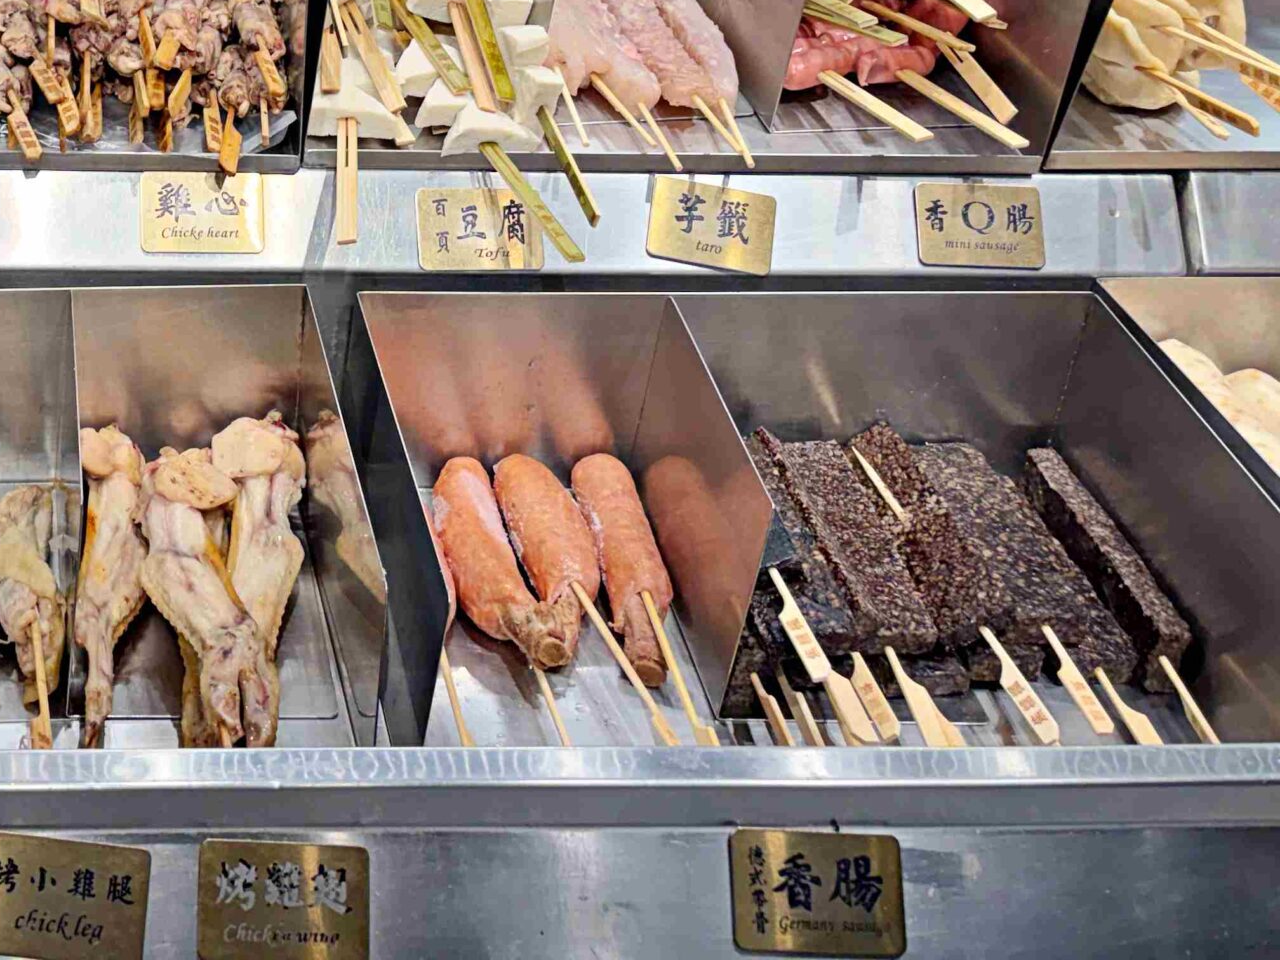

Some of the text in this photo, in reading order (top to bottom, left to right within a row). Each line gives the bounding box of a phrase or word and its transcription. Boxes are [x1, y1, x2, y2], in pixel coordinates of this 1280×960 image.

[155, 182, 248, 223] 雞心
[924, 199, 1035, 235] 香Q腸
[206, 227, 239, 238] heart
[432, 198, 450, 254] 百頁
[456, 199, 526, 245] 豆腐
[474, 247, 511, 260] Tofu
[695, 240, 723, 254] taro
[944, 239, 1019, 254] mini sausage
[772, 852, 883, 913] 香腸
[14, 908, 72, 940] chick
